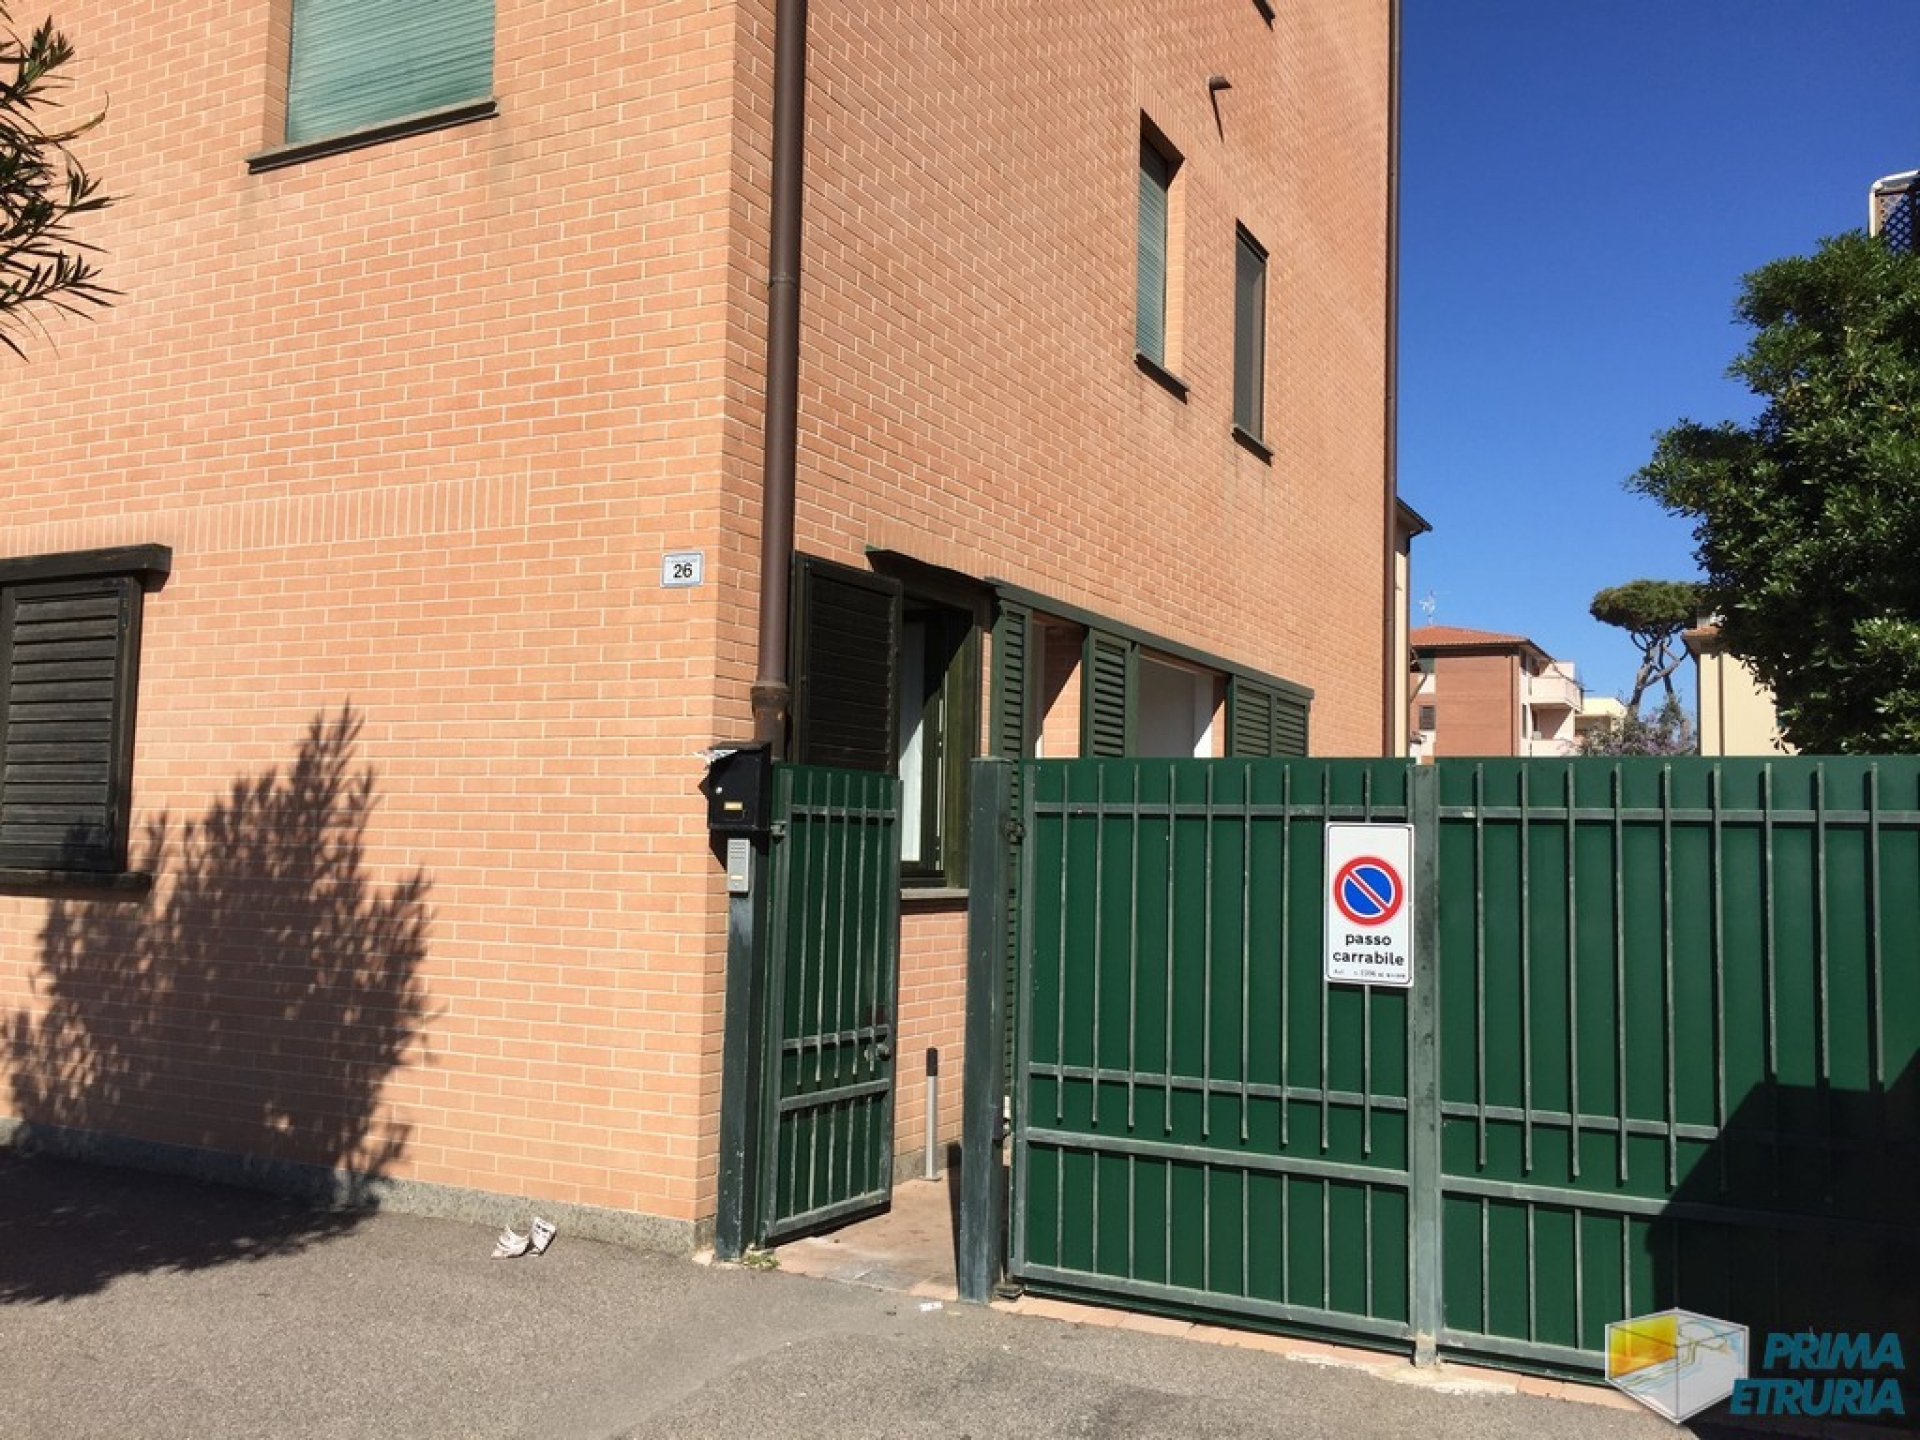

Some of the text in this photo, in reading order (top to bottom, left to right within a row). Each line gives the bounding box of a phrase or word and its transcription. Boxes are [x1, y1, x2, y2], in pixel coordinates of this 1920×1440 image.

[673, 562, 693, 579] 26
[1345, 934, 1392, 947] passo
[1332, 951, 1405, 966] carrabile
